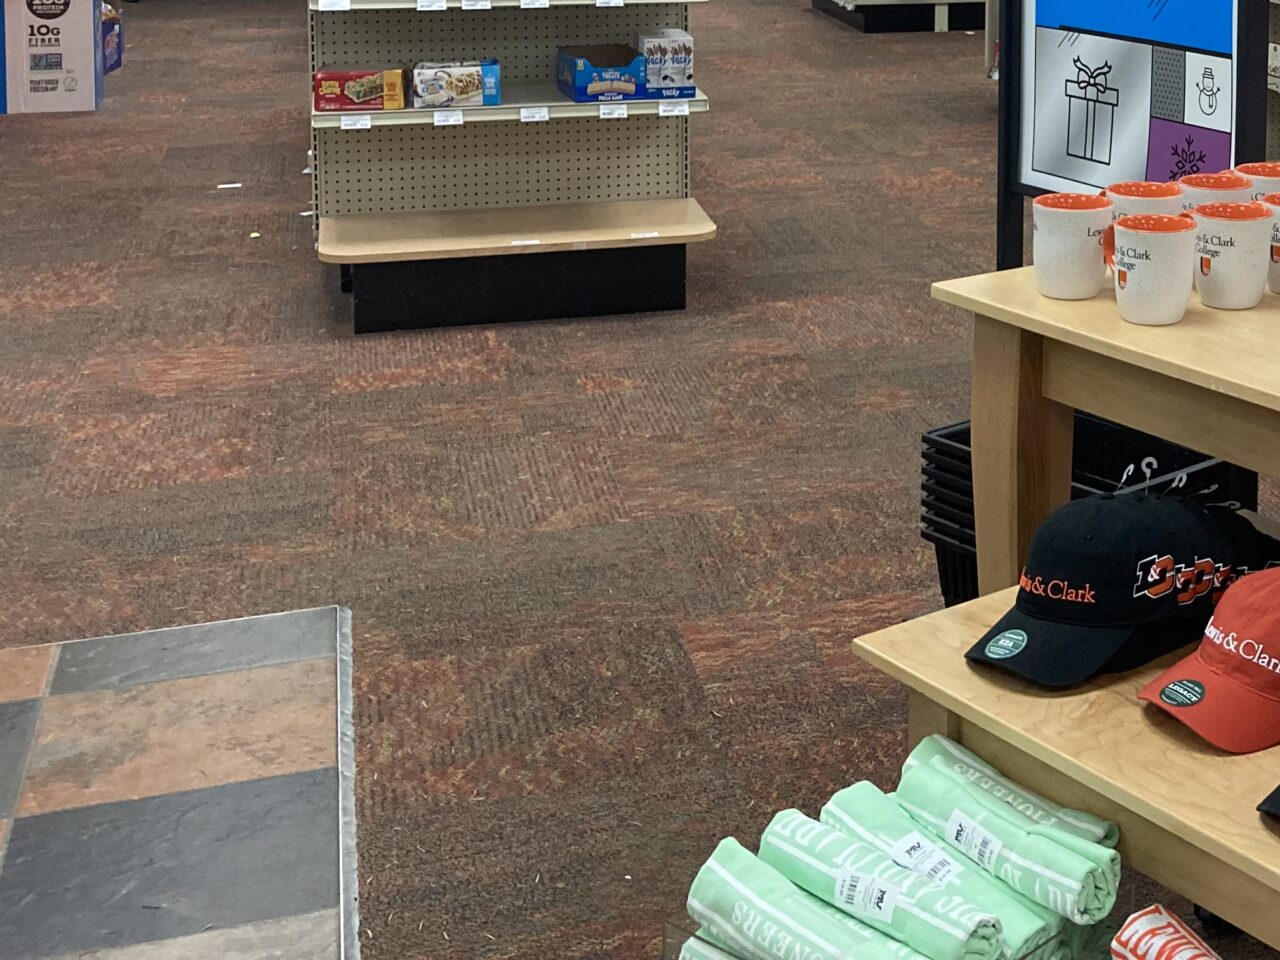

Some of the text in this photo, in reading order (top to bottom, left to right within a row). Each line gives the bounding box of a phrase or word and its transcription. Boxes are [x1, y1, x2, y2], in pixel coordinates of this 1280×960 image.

[28, 24, 61, 37] 10G
[1272, 223, 1280, 234] &
[1202, 235, 1236, 247] & Clark
[1119, 247, 1152, 261] & Clark
[1031, 576, 1096, 604] & Clark
[1223, 632, 1238, 652] &
[1167, 683, 1199, 702] LEGACY
